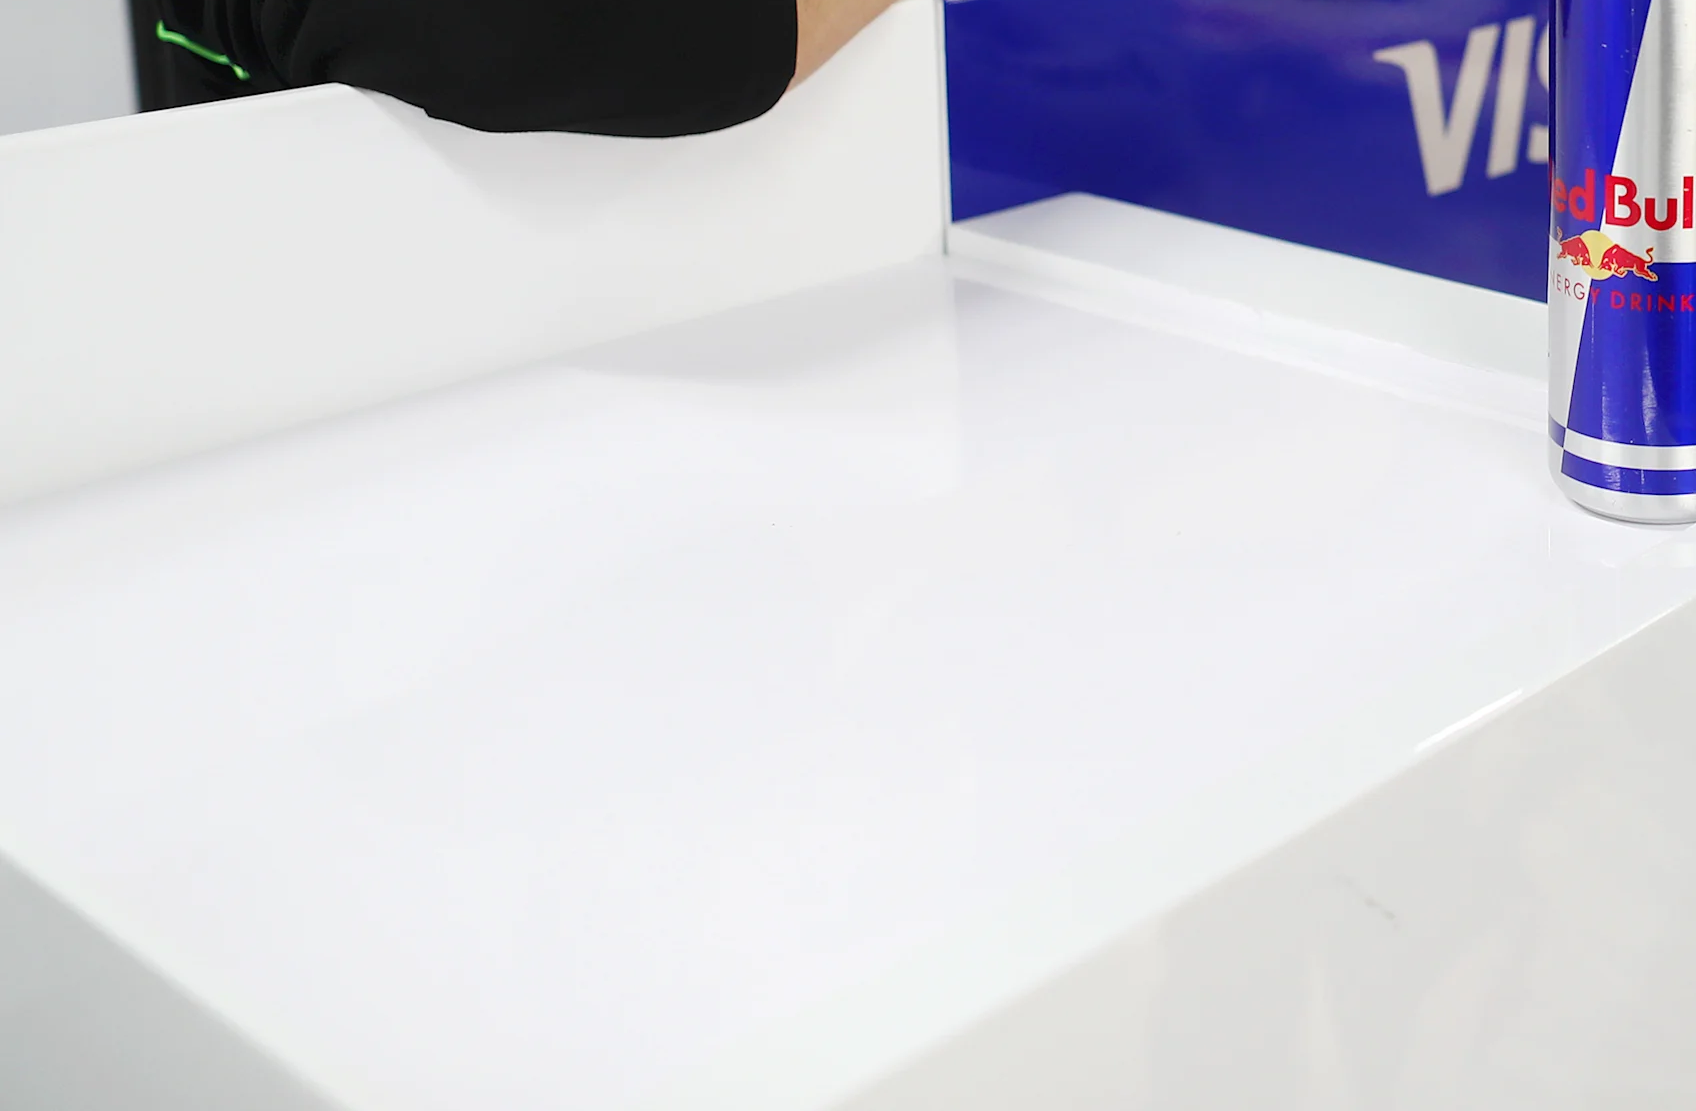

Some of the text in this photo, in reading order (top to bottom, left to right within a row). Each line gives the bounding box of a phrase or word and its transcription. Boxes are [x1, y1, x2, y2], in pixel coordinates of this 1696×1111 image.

[1373, 15, 1550, 197] VI
[1549, 168, 1596, 223] ed
[1550, 269, 1696, 313] NERGY DRINK
